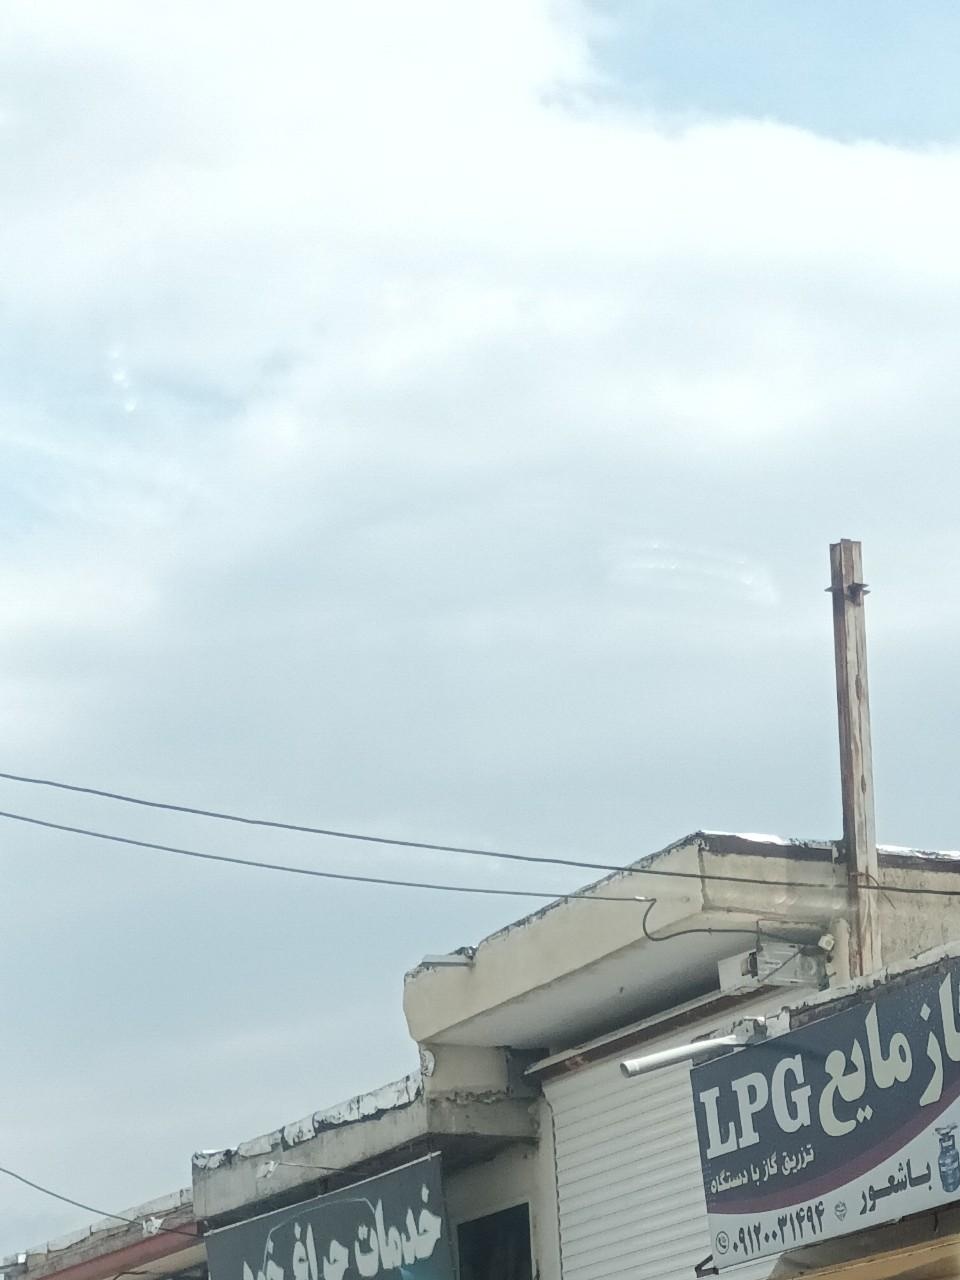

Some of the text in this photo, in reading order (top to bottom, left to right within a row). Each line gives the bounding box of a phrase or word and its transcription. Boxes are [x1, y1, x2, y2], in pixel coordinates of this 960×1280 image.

[699, 1053, 812, 1160] LPG
[818, 1002, 913, 1137] مایع
[710, 1143, 815, 1194] تزریق گاز با دستگاه
[354, 1183, 442, 1278] خدمات
